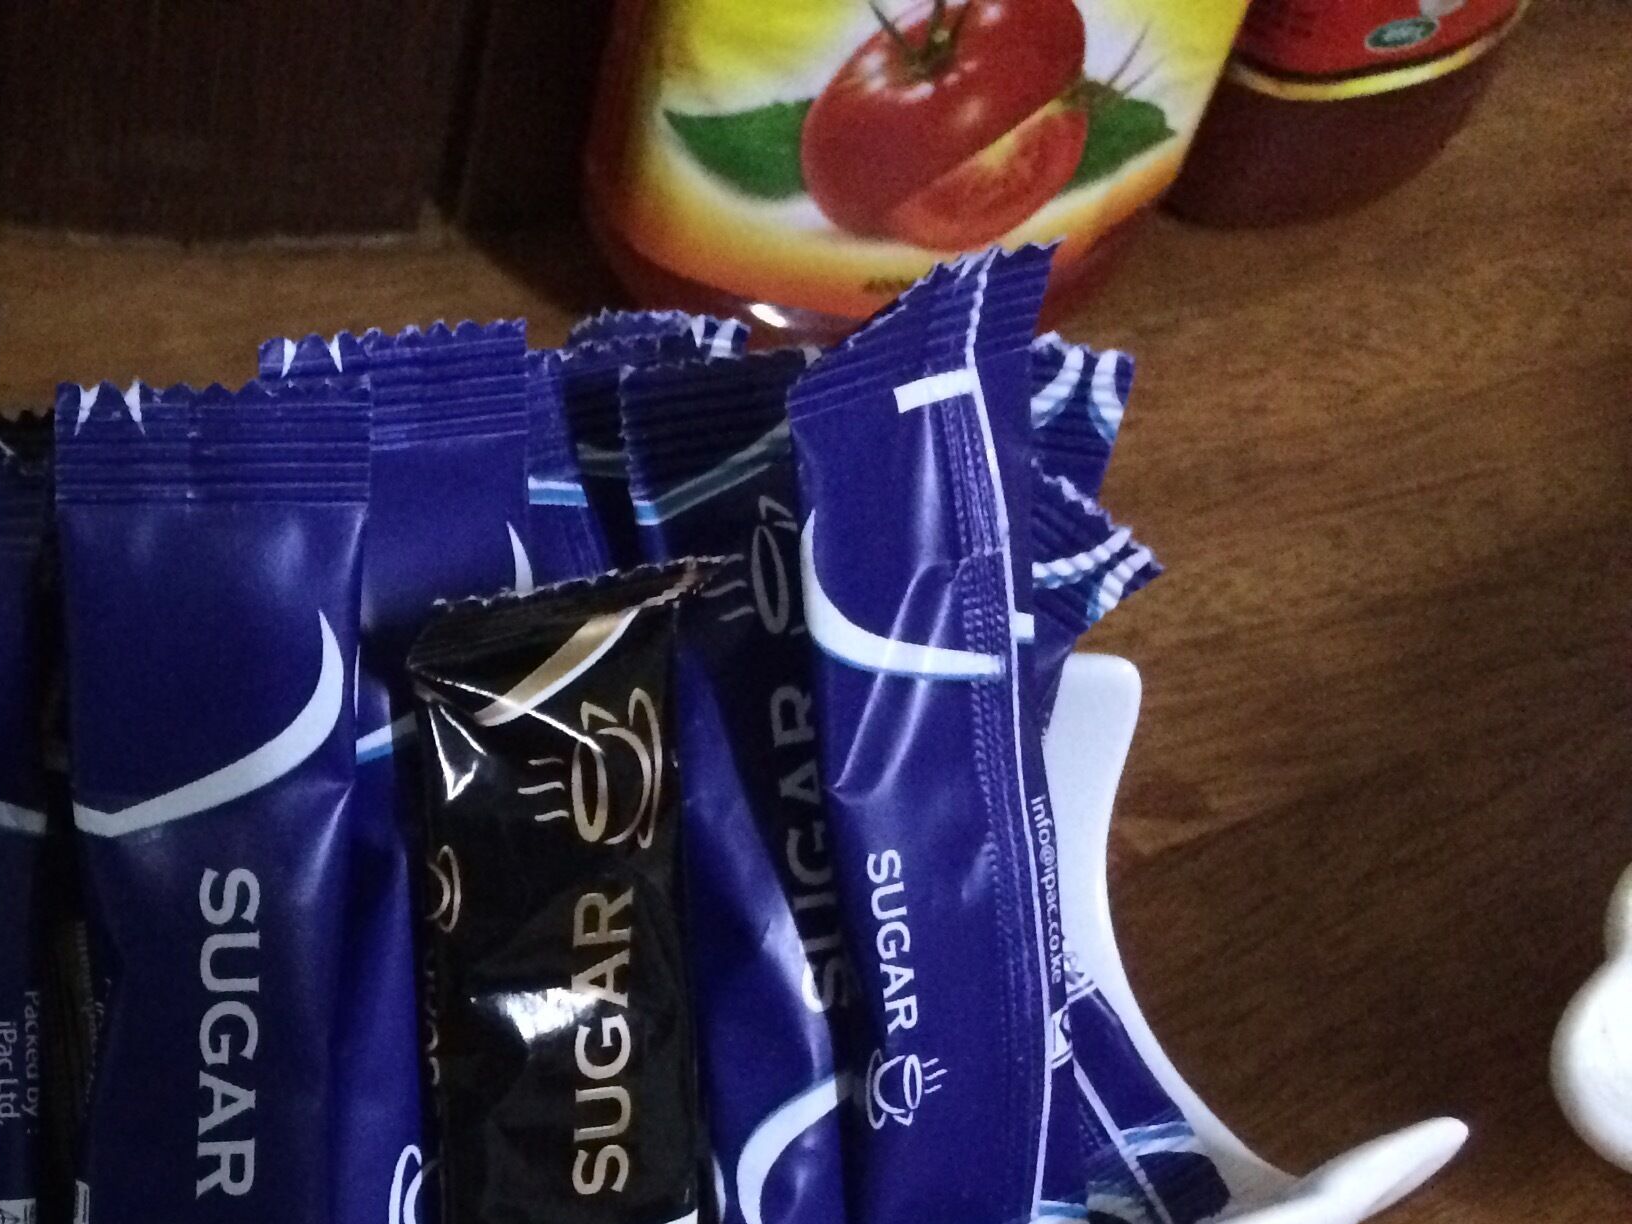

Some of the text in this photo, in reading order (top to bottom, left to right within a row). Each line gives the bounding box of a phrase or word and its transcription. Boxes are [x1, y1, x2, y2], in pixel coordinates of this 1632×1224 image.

[196, 867, 261, 1200] SUGAR
[570, 886, 636, 1196] SUGAR
[866, 848, 919, 1035] SUGAR
